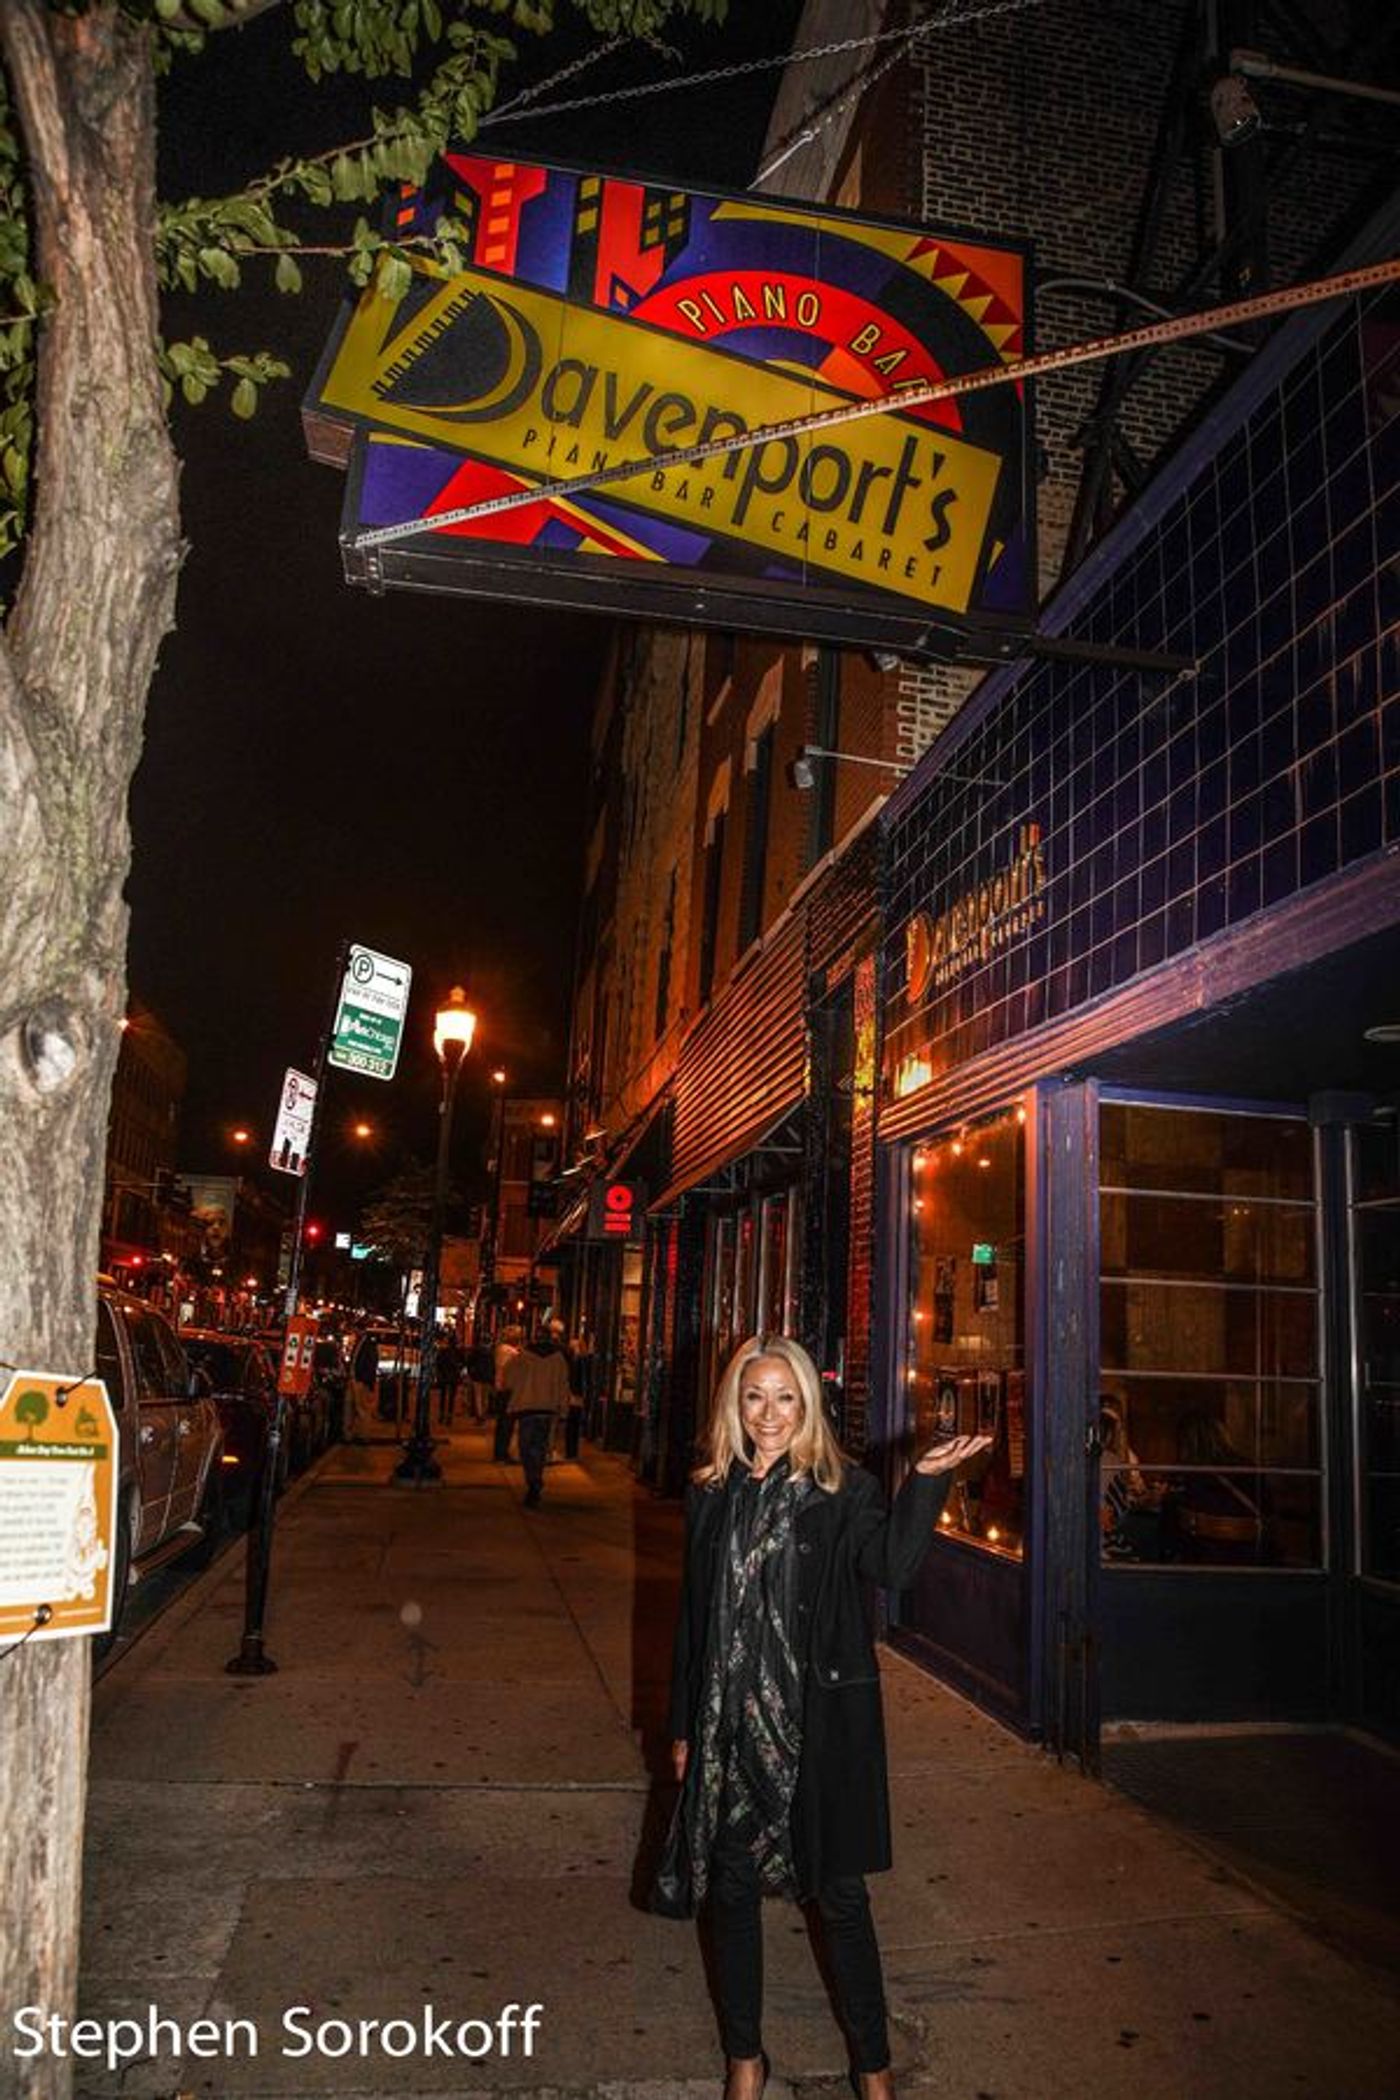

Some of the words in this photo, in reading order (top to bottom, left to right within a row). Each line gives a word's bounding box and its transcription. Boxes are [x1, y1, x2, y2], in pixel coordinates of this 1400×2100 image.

[676, 284, 820, 332] PIANO
[370, 286, 958, 552] Davenport's
[521, 428, 638, 482] PIAN
[650, 470, 716, 510] BAR
[771, 510, 942, 587] CABARET
